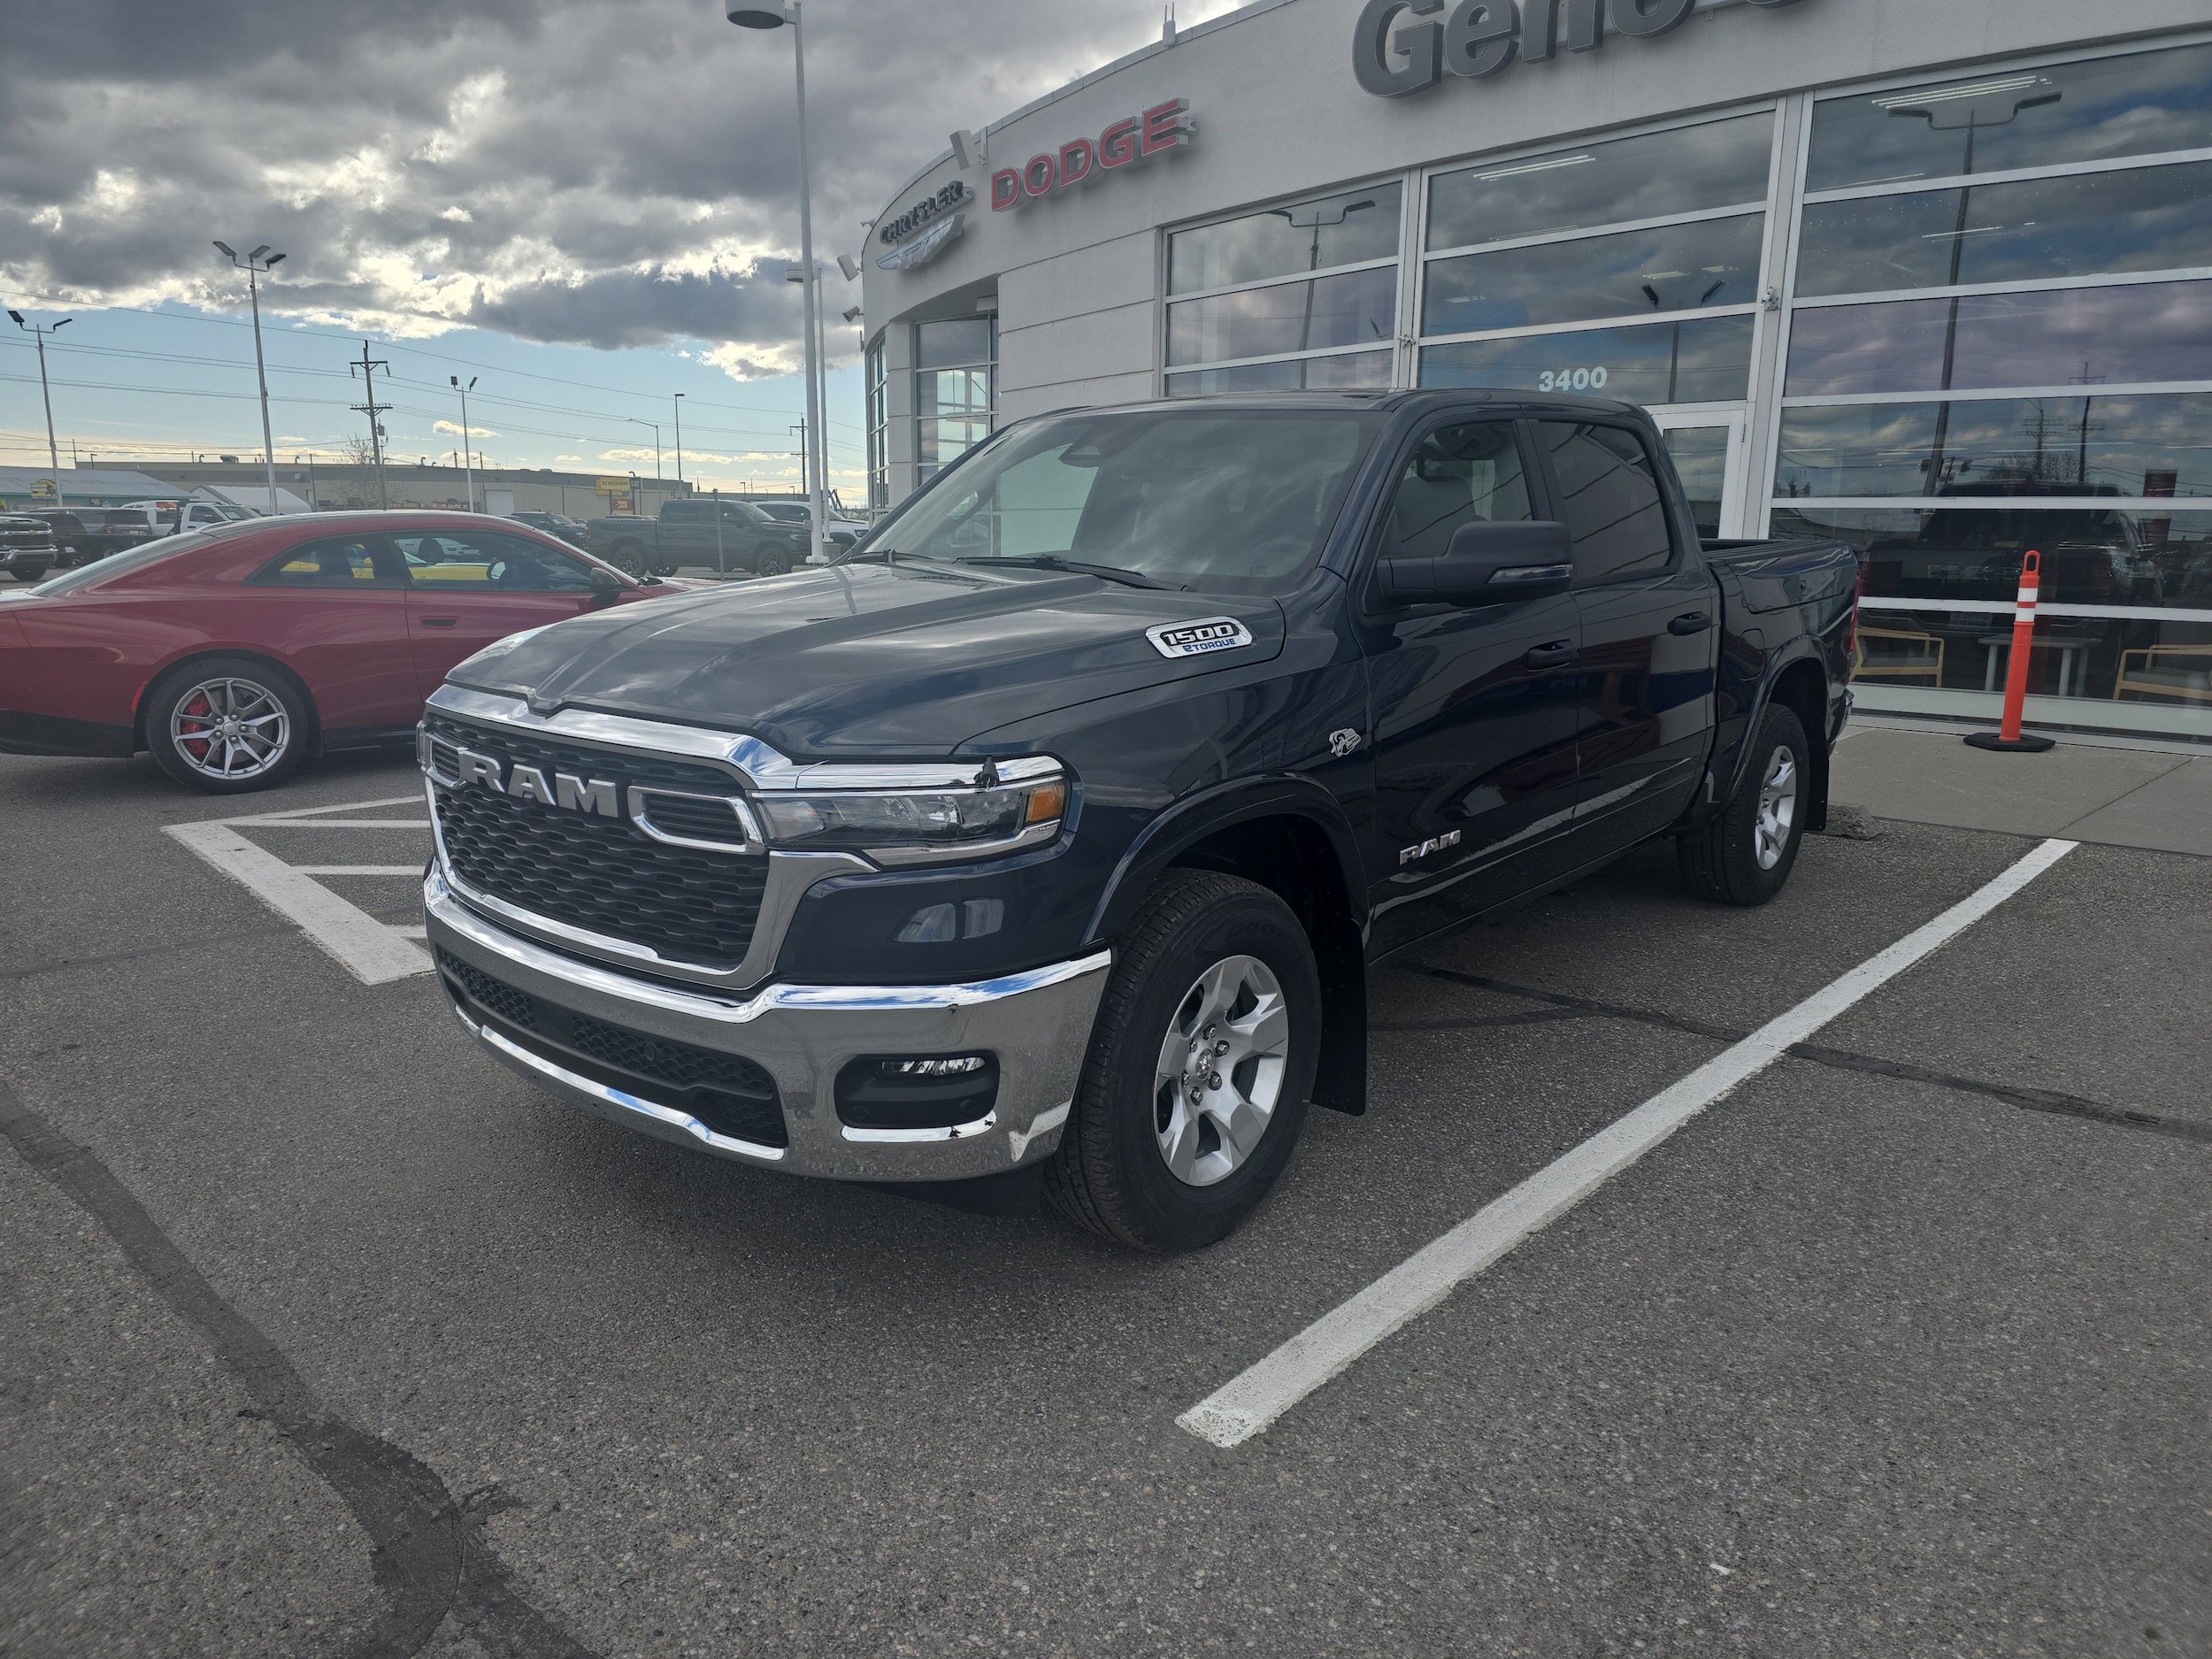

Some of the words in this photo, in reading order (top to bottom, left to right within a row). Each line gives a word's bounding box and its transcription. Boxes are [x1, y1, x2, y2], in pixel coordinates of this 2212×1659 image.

[1352, 0, 1801, 99] Gen
[991, 98, 1189, 212] DODGE
[879, 180, 964, 245] CHRYSLER
[1538, 365, 1608, 392] 3400
[1163, 624, 1234, 646] 1500
[459, 749, 618, 818] RAM
[1399, 830, 1461, 865] RAM
